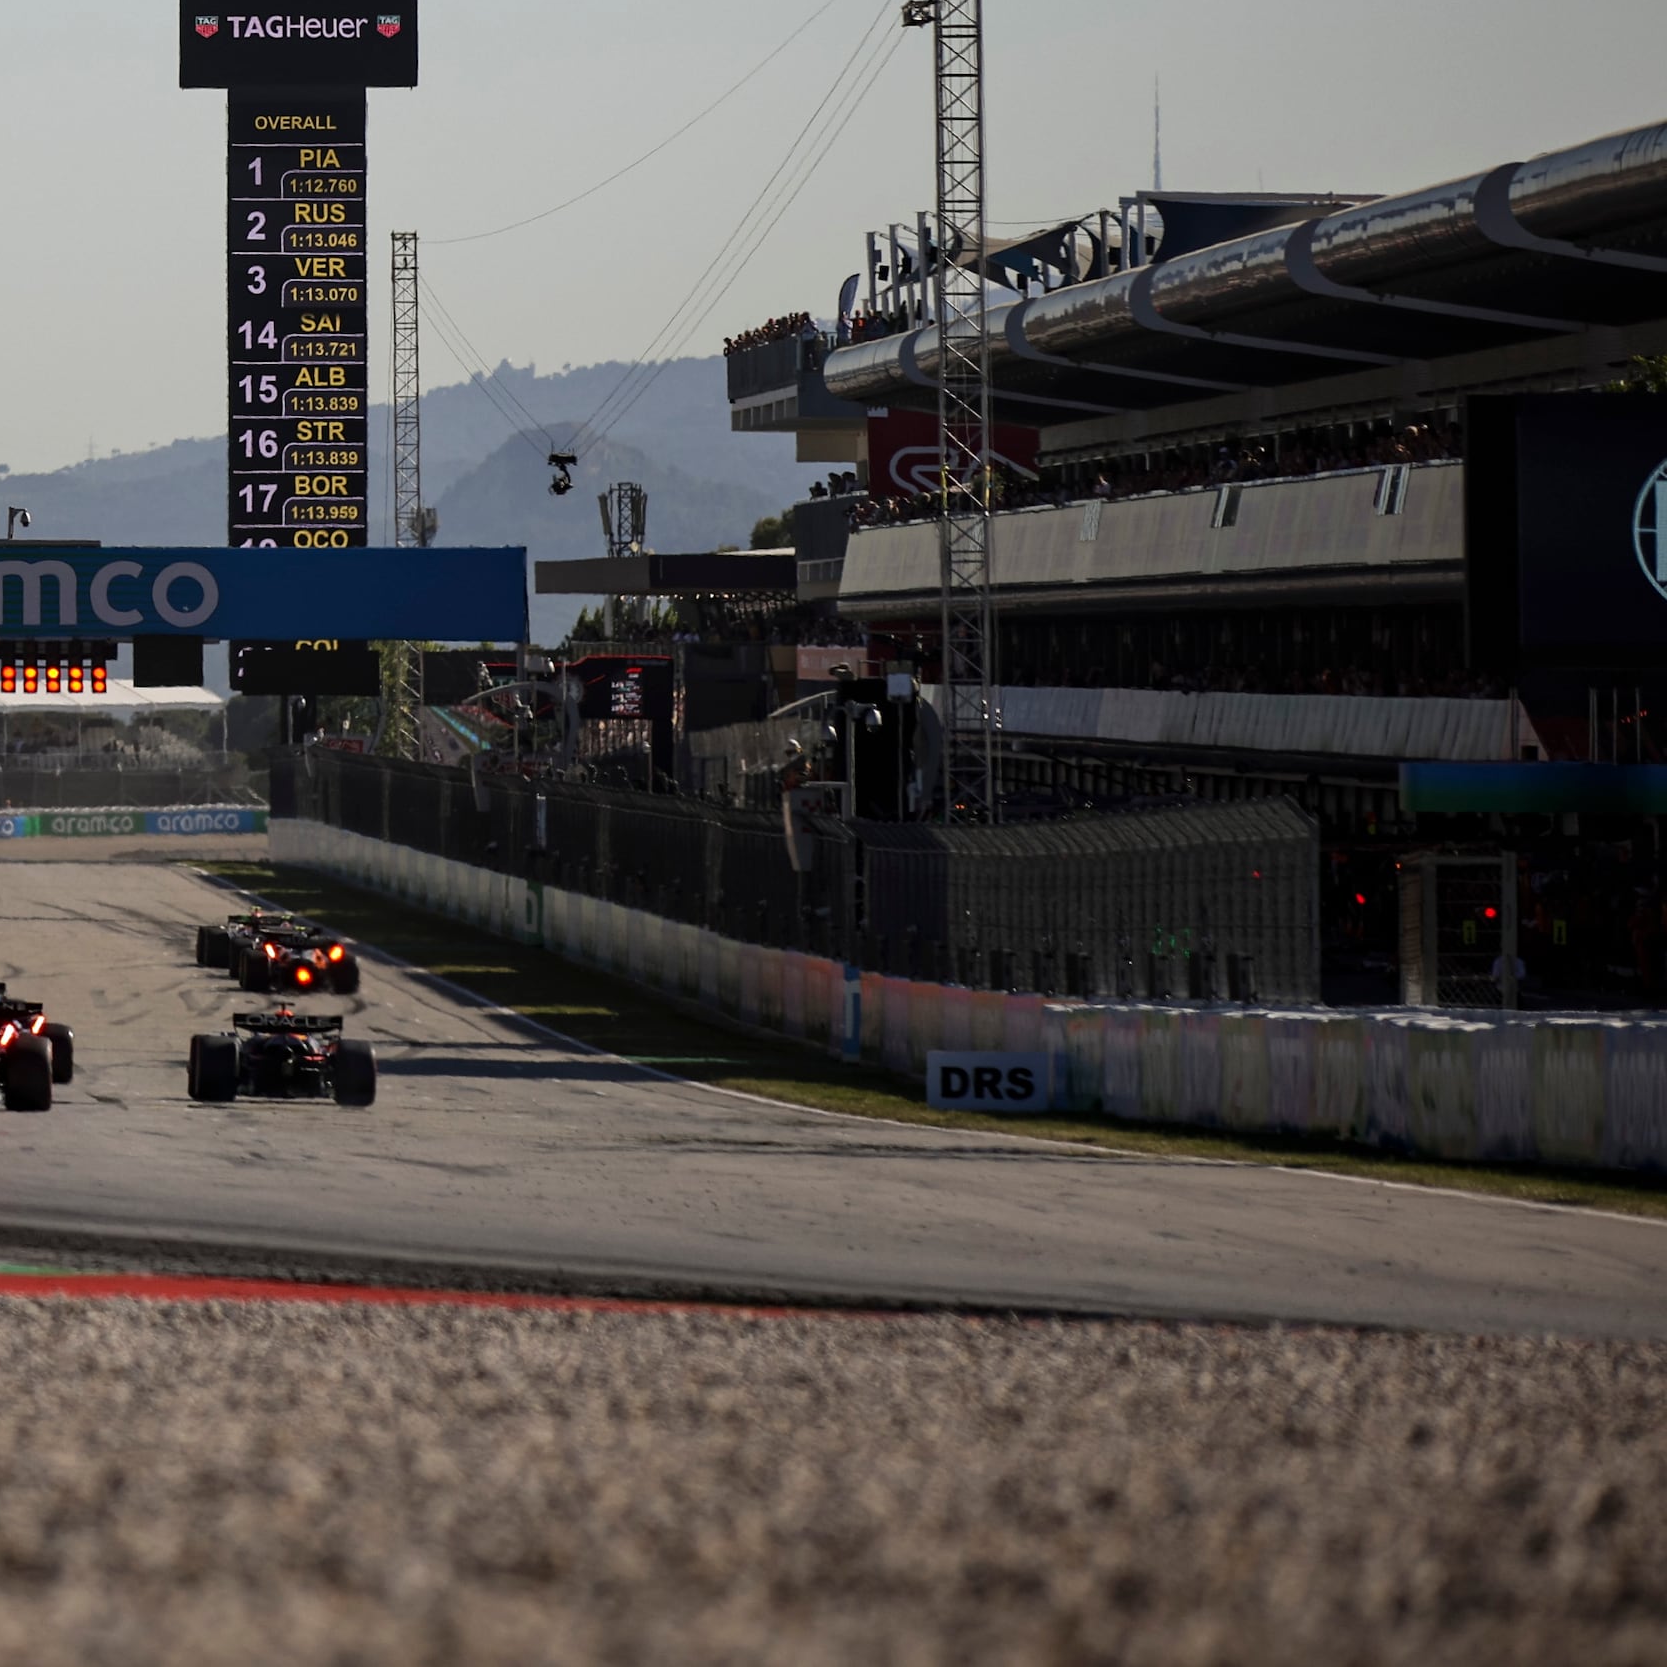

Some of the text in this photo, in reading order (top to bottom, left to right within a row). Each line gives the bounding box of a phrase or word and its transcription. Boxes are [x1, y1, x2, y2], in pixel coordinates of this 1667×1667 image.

[255, 116, 337, 130] OVERALL
[300, 149, 340, 168] PIA
[248, 157, 262, 185] 1
[290, 179, 357, 193] 1:12.760
[295, 203, 345, 223] RUS
[246, 212, 266, 240] 2
[290, 234, 357, 247] 1:13.046
[295, 258, 346, 277] VER
[247, 266, 267, 294] 3
[290, 288, 358, 301] 1:13.070
[300, 313, 341, 332] SAI
[238, 320, 278, 349] 14
[291, 342, 356, 356] 1:13.721
[295, 367, 346, 387] ALB
[238, 375, 278, 403] 15
[291, 397, 358, 411] 1:13.839
[297, 421, 345, 441] STR
[238, 430, 278, 458] 16
[291, 452, 358, 465] 1:13.839
[294, 476, 348, 495] BOR
[238, 484, 278, 513] 17
[291, 506, 358, 519] 1:13.959
[294, 530, 348, 548] OCO
[51, 814, 134, 833] aramco
[157, 812, 240, 831] aramco
[939, 1065, 1036, 1102] DRS
